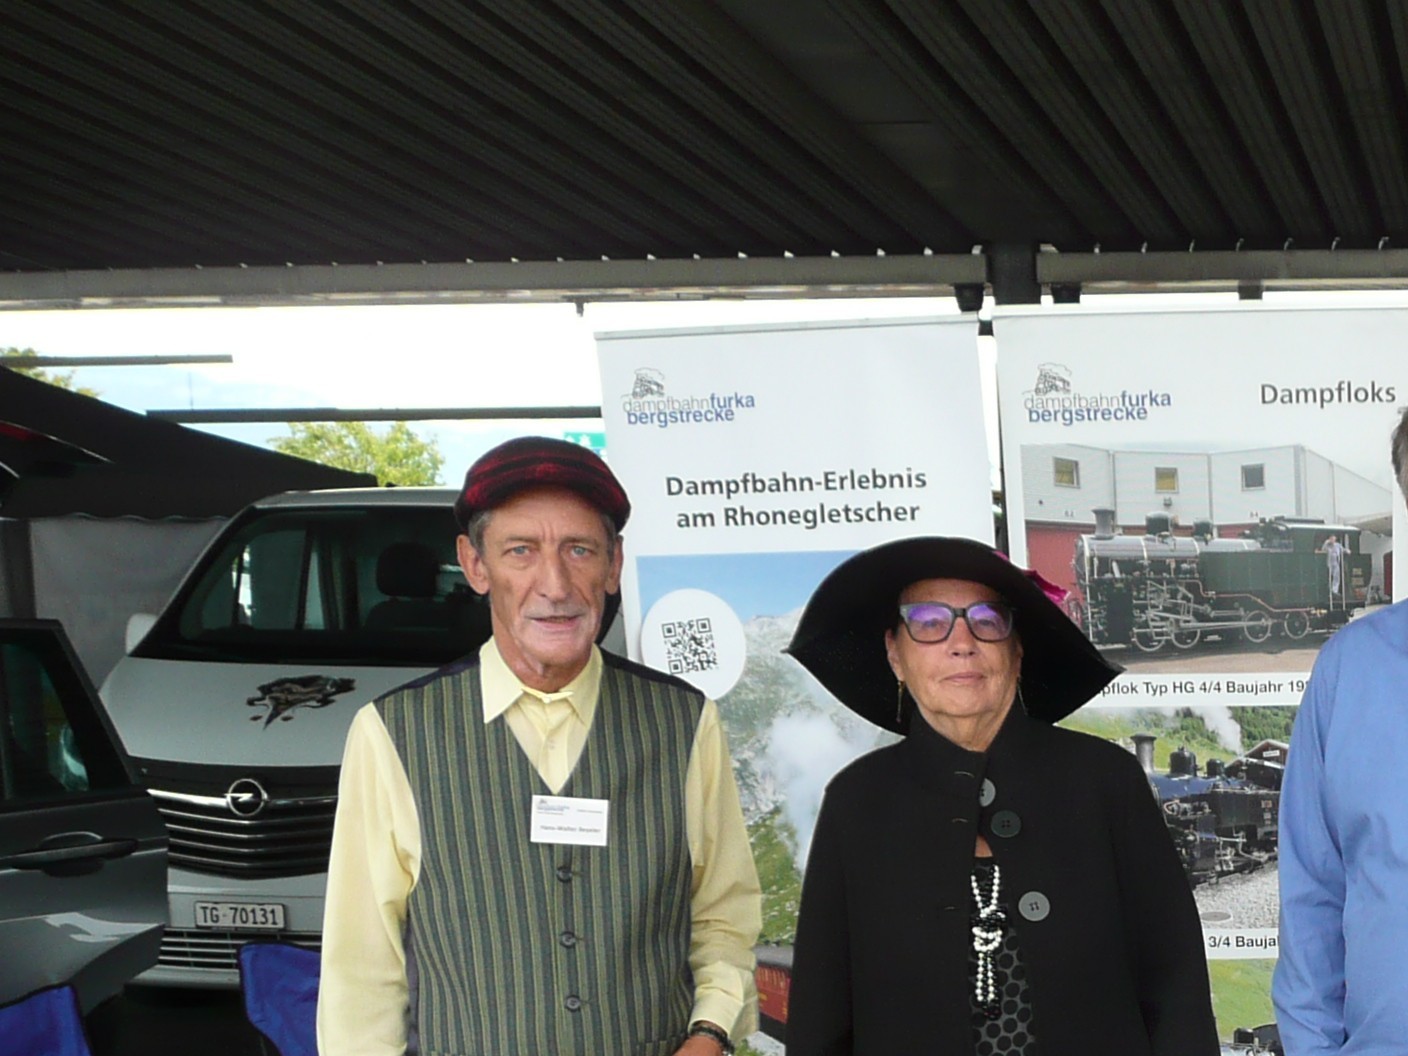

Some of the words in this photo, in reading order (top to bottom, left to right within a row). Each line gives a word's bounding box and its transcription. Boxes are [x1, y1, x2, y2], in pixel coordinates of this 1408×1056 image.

[1261, 381, 1397, 409] Dampfloks
[627, 408, 735, 428] bergstrecke
[1029, 406, 1148, 426] bergstrecke
[665, 468, 927, 500] Dampfbahn-Erlebnis
[676, 511, 716, 528] am
[724, 501, 920, 530] Rhonegletscher
[1102, 681, 1139, 697] pflok
[1142, 681, 1168, 697] Typ
[1172, 681, 1195, 694] HG
[1199, 680, 1222, 694] 4/4
[1226, 680, 1284, 696] Baujahr
[1289, 680, 1309, 693] 19
[200, 906, 220, 924] TG
[229, 907, 279, 926] 70131
[1208, 935, 1231, 948] 3/4
[1235, 935, 1279, 950] Bauja
